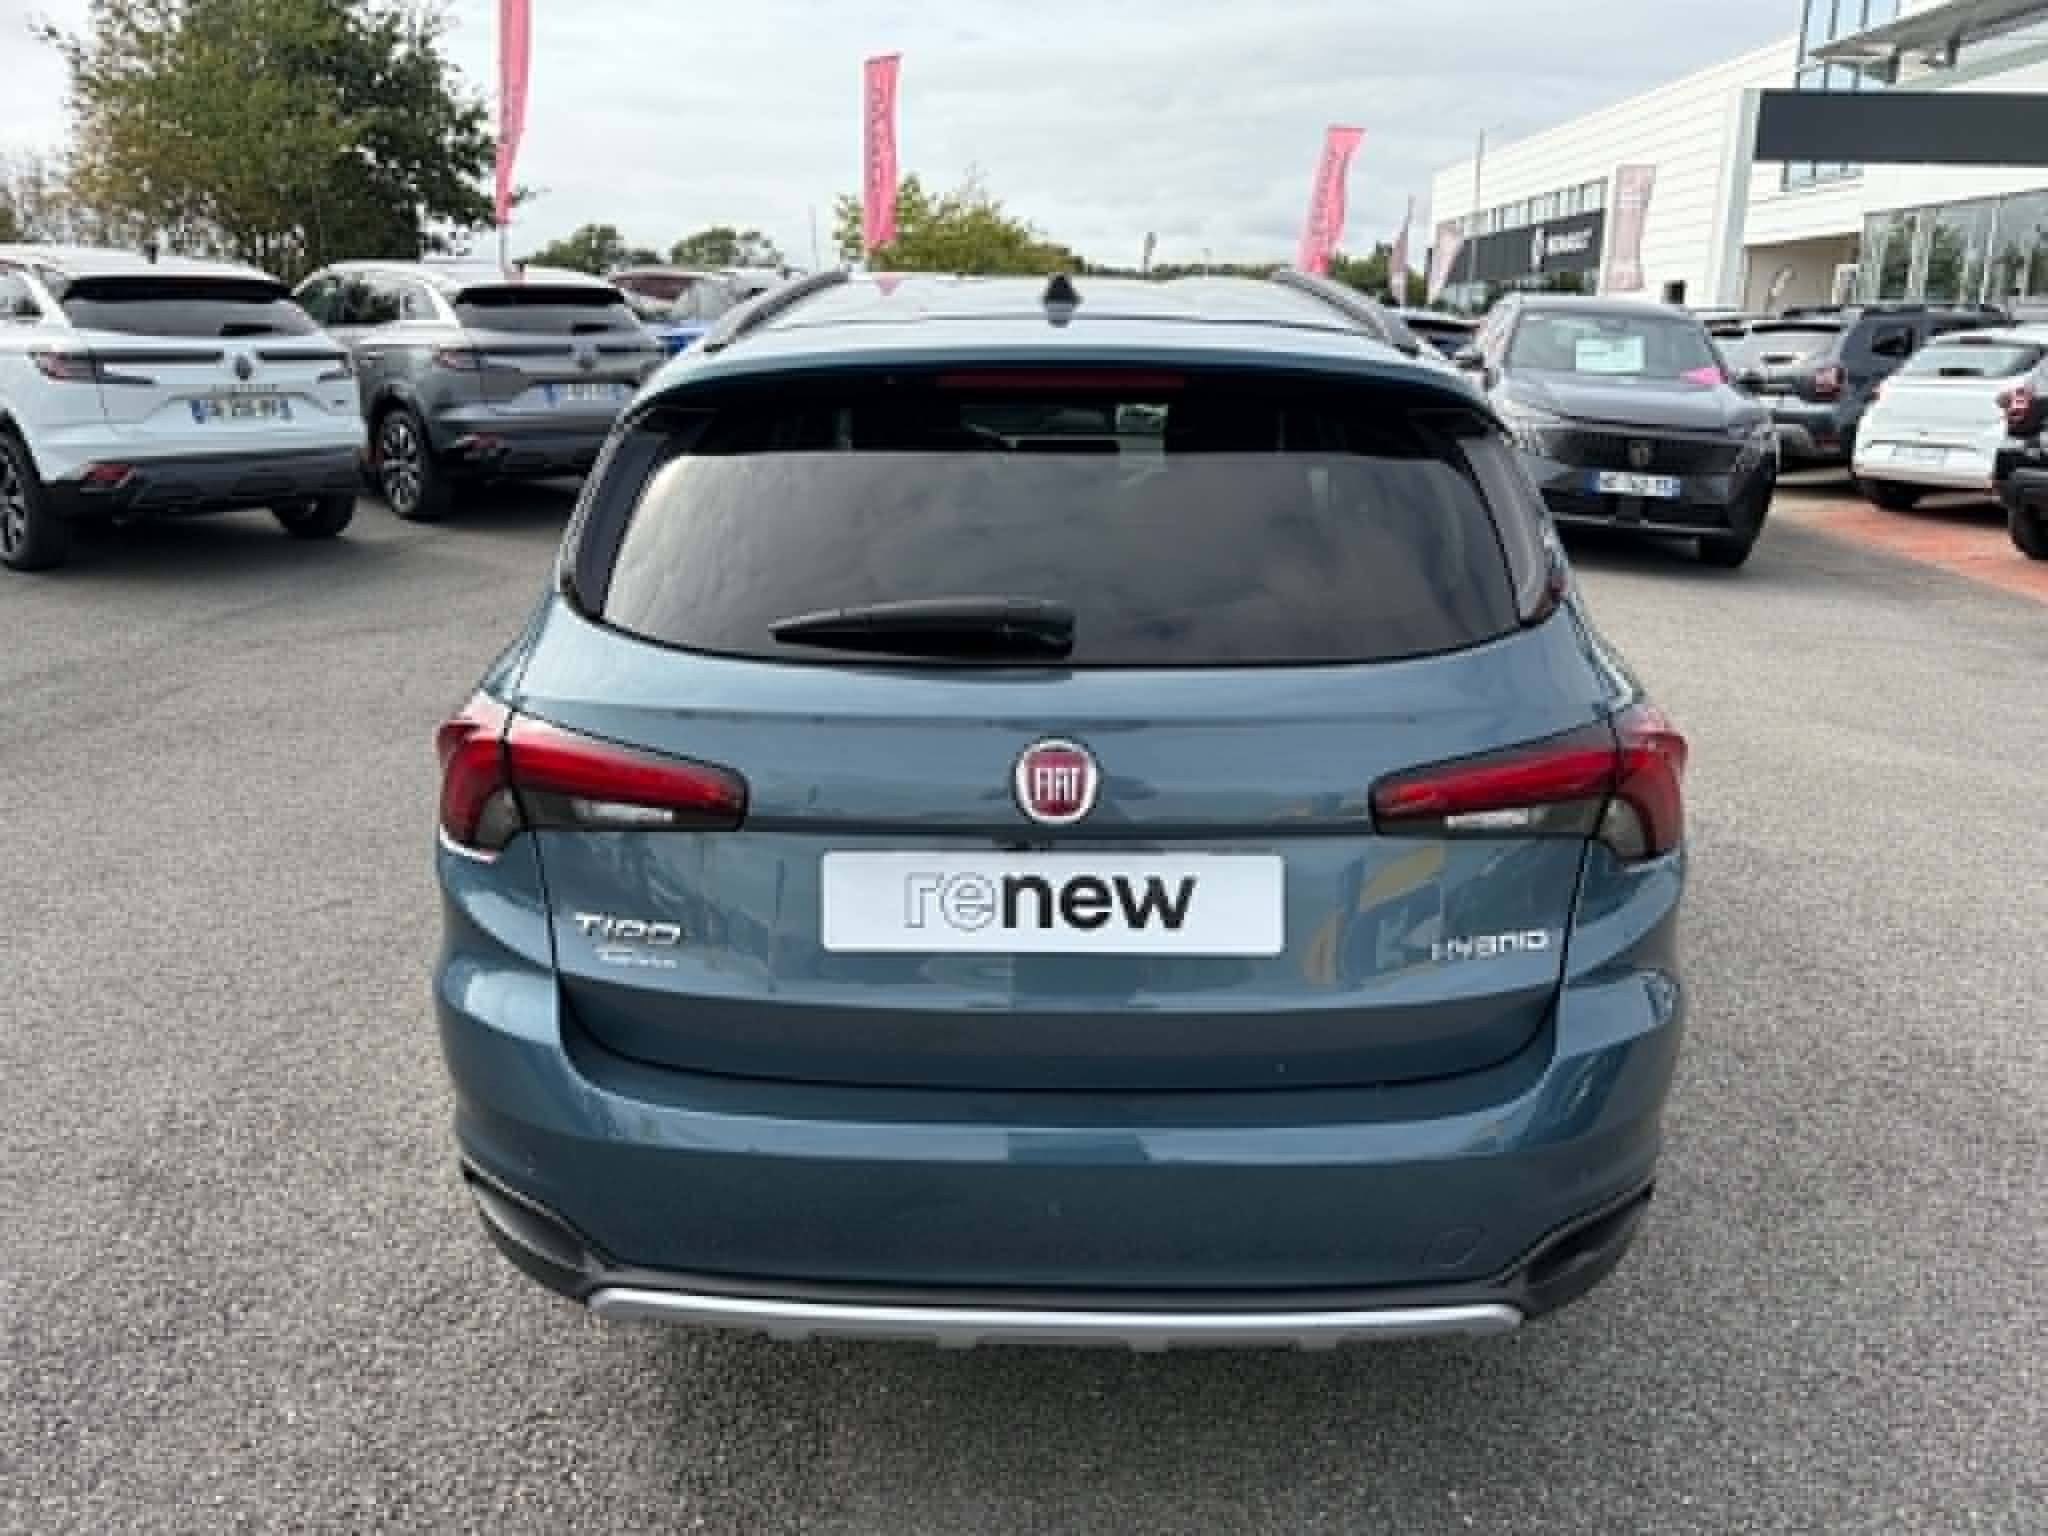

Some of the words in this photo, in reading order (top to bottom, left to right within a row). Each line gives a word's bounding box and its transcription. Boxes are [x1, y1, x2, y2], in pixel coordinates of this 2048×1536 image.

[1034, 767, 1080, 801] FIAT
[903, 871, 1198, 932] renew
[1430, 927, 1549, 961] HYBRID
